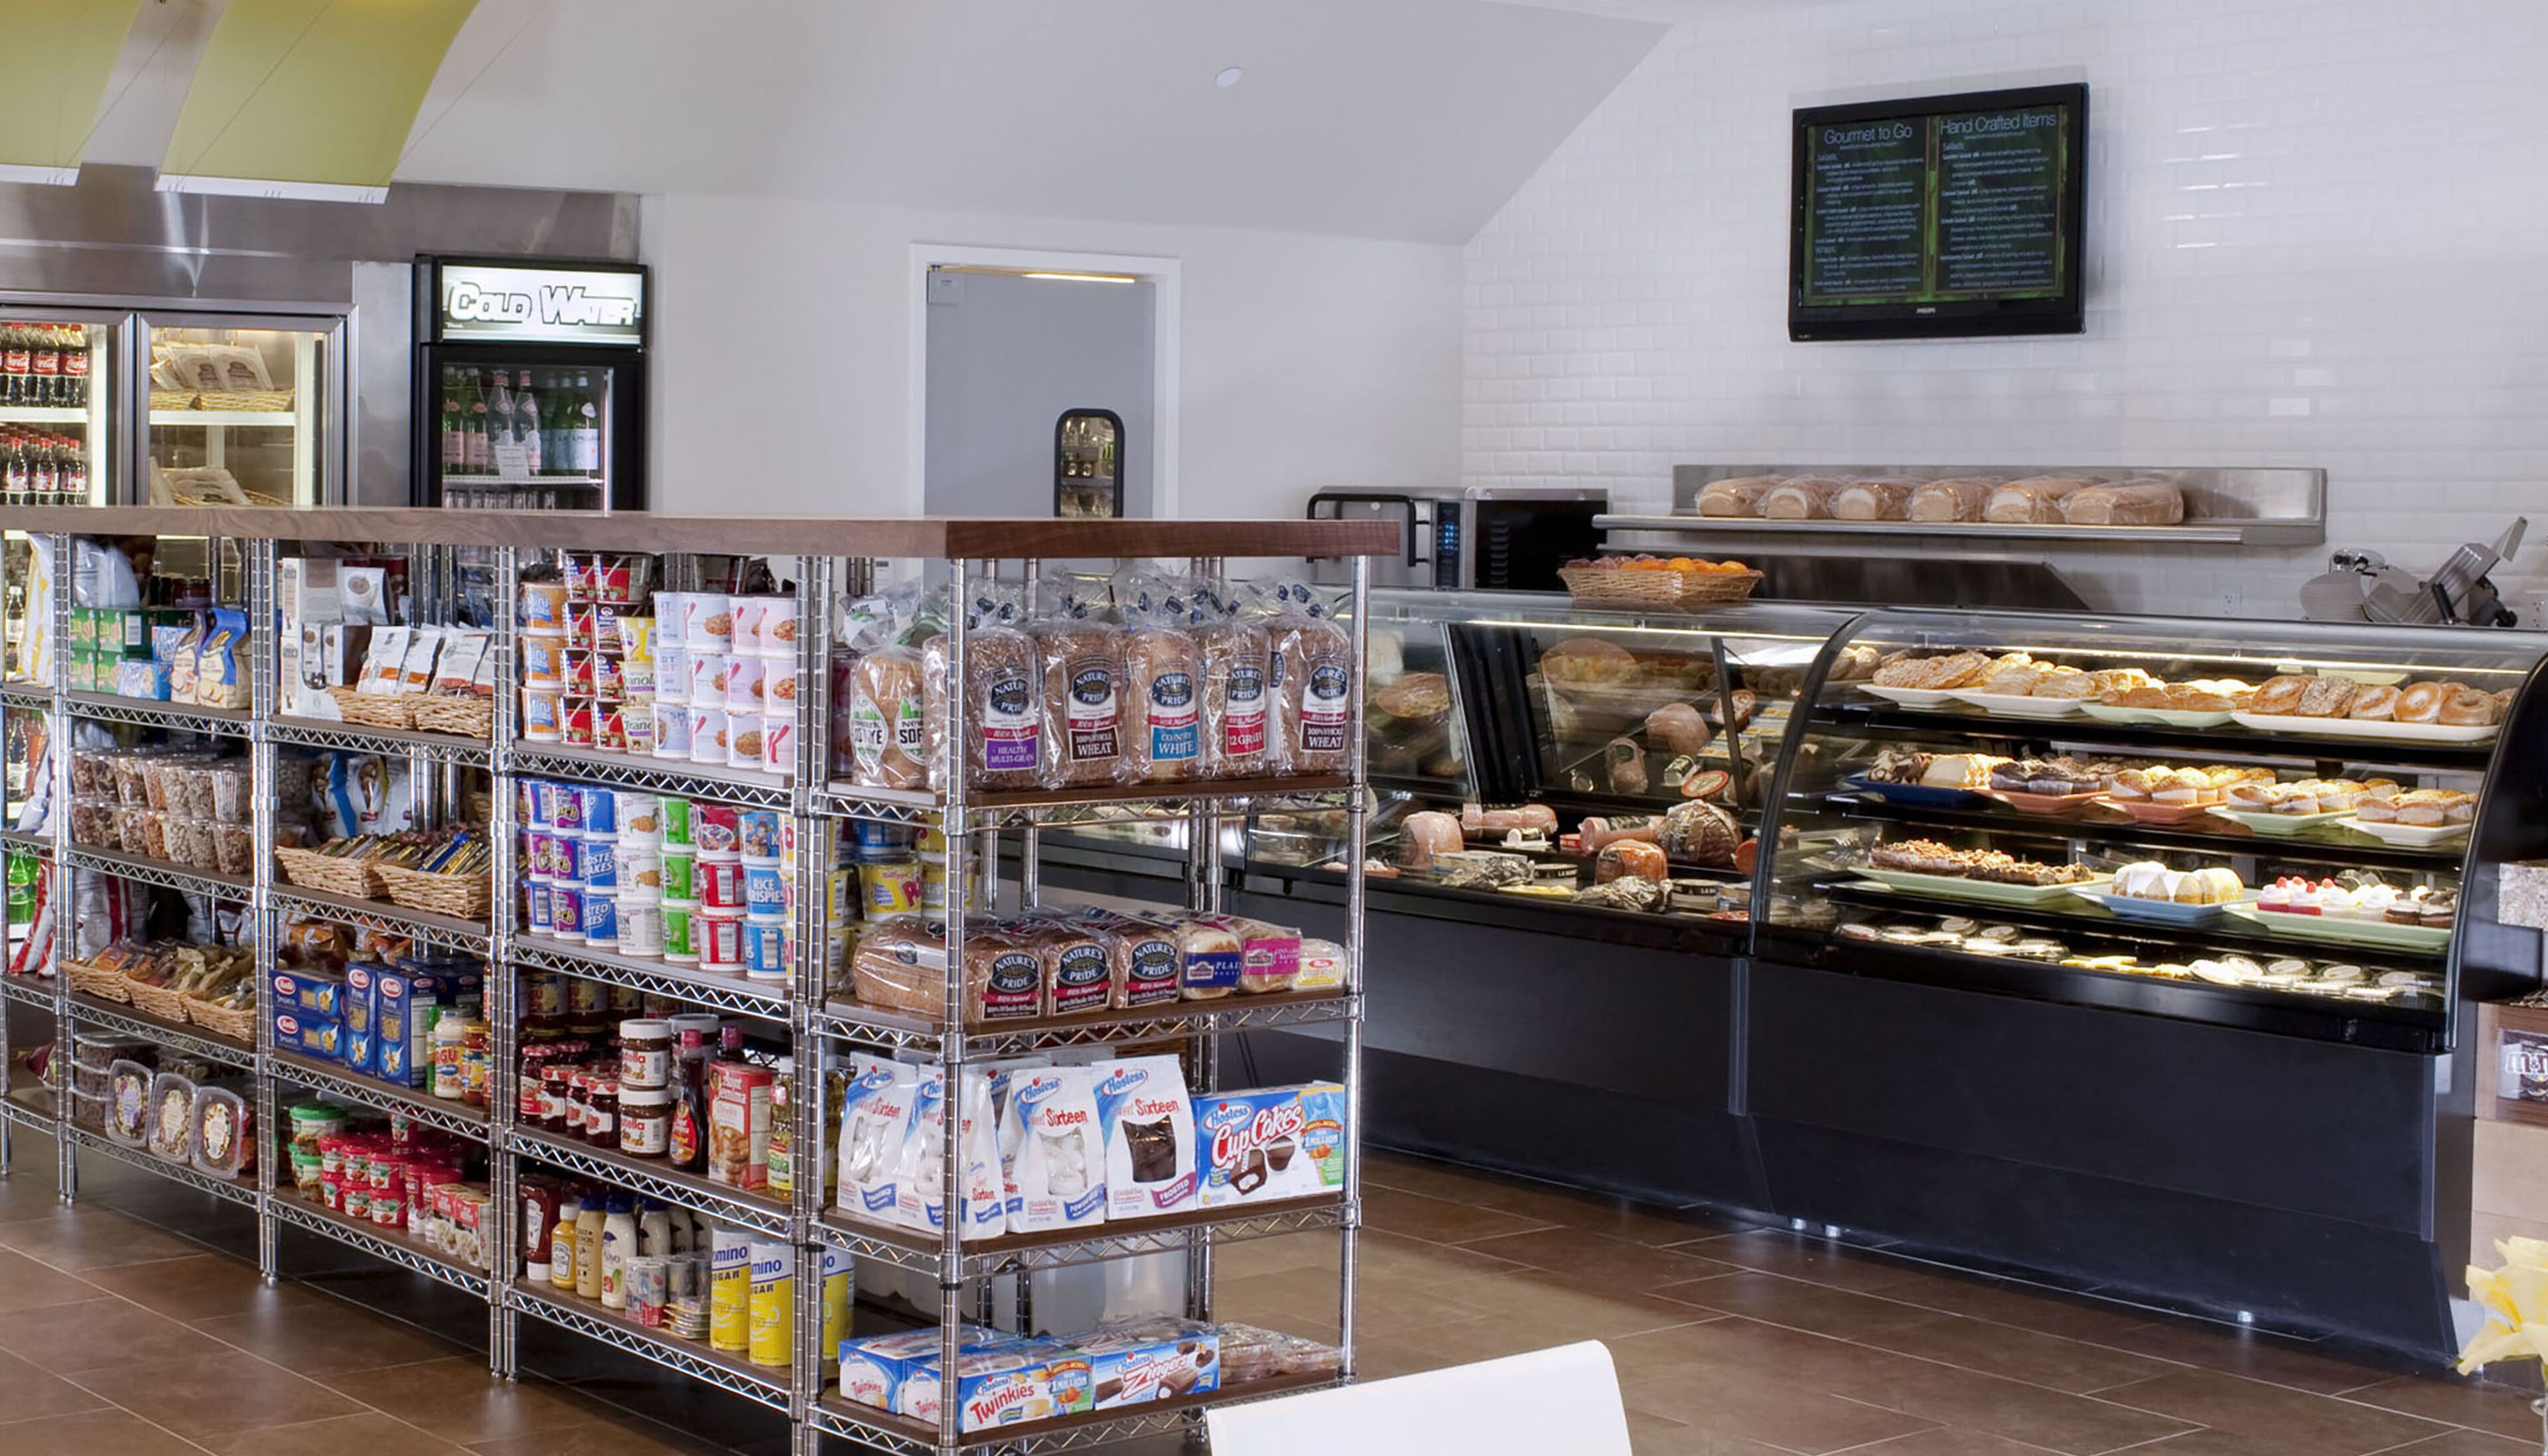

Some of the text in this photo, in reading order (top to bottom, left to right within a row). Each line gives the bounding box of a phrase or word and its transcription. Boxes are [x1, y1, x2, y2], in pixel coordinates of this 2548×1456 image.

[1940, 113, 2056, 134] Hand Crafted Items
[1824, 123, 1913, 145] Gourmet to Go
[627, 673, 655, 685] anol
[900, 728, 922, 744] SOF
[1309, 736, 1342, 748] WHEAT
[1077, 742, 1113, 756] WHEAT
[1158, 741, 1194, 755] WHITE
[588, 861, 614, 875] AKES
[752, 879, 775, 890] RICE
[1062, 947, 1103, 966] NATURE'S
[1135, 943, 1175, 960] NATURE'S
[996, 956, 1035, 971] NATURE'S
[1142, 963, 1170, 976] PRIDE
[1001, 976, 1029, 988] PRIDE
[1069, 968, 1098, 981] PRIDE
[622, 1051, 646, 1064] tella
[1025, 1079, 1060, 1098] Hostess
[1107, 1071, 1145, 1094] Hostess
[1135, 1098, 1179, 1117] Sixteen
[621, 1118, 645, 1130] tella
[1046, 1107, 1088, 1126] Sixteen
[1211, 1106, 1249, 1128] Hostess
[713, 1243, 748, 1262] omino
[751, 1256, 782, 1275] mino
[713, 1270, 740, 1281] GAR
[969, 1384, 1034, 1425] Twinkies
